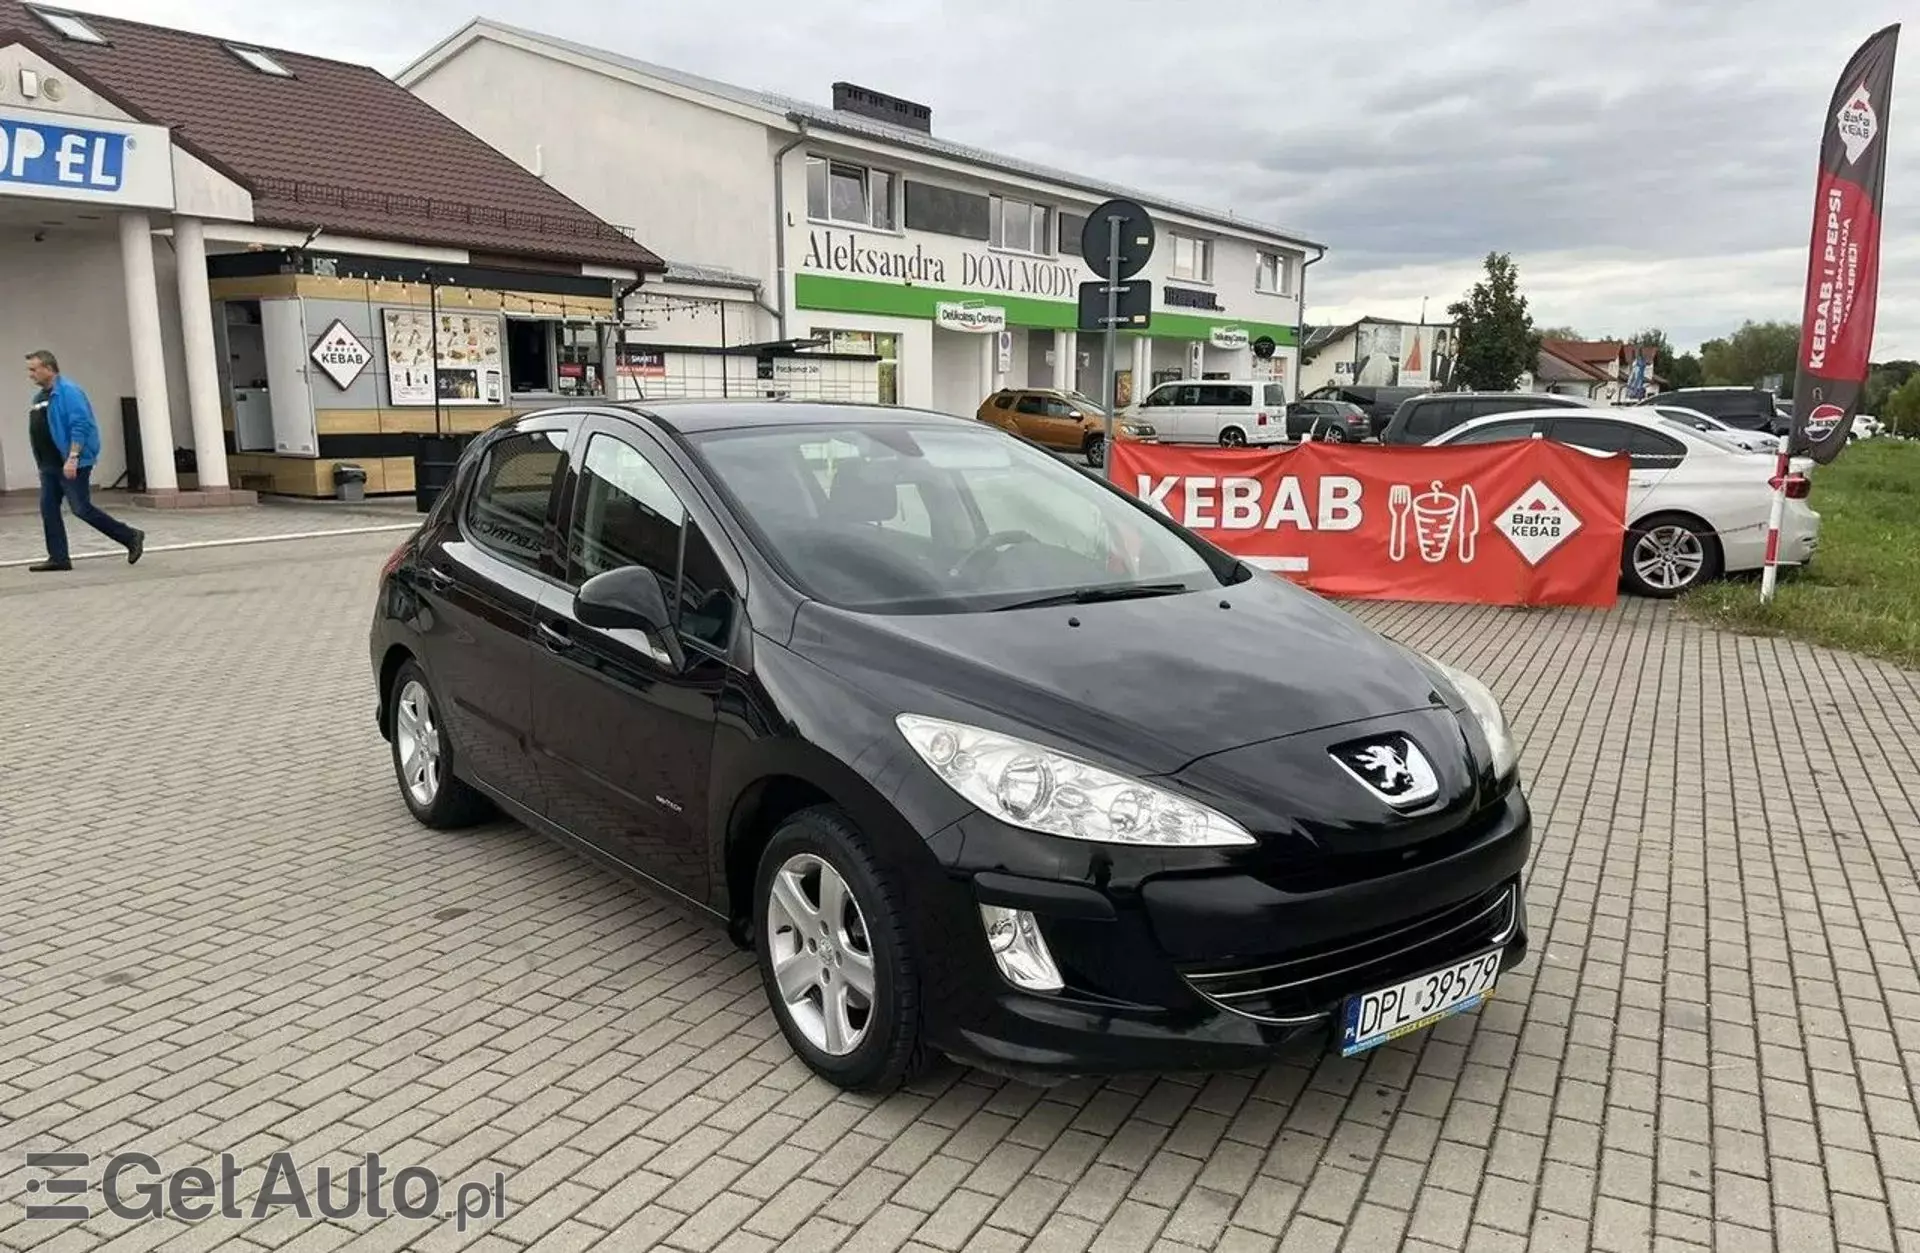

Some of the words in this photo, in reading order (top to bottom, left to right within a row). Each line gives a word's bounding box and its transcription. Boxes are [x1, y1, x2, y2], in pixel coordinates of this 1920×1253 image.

[803, 230, 946, 283] Aleksandra
[962, 252, 1014, 292] DOM
[1020, 261, 1077, 298] MODY
[1809, 282, 1833, 369] KEBAB
[1824, 189, 1842, 263] PEPSI
[321, 353, 363, 364] KEBAB
[1137, 474, 1363, 531] KEBAB
[1512, 513, 1561, 525] Bafra
[1512, 525, 1560, 537] KEBAB
[1359, 986, 1410, 1037] DPL
[1421, 953, 1498, 1012] 39579
[1344, 1027, 1355, 1040] PL
